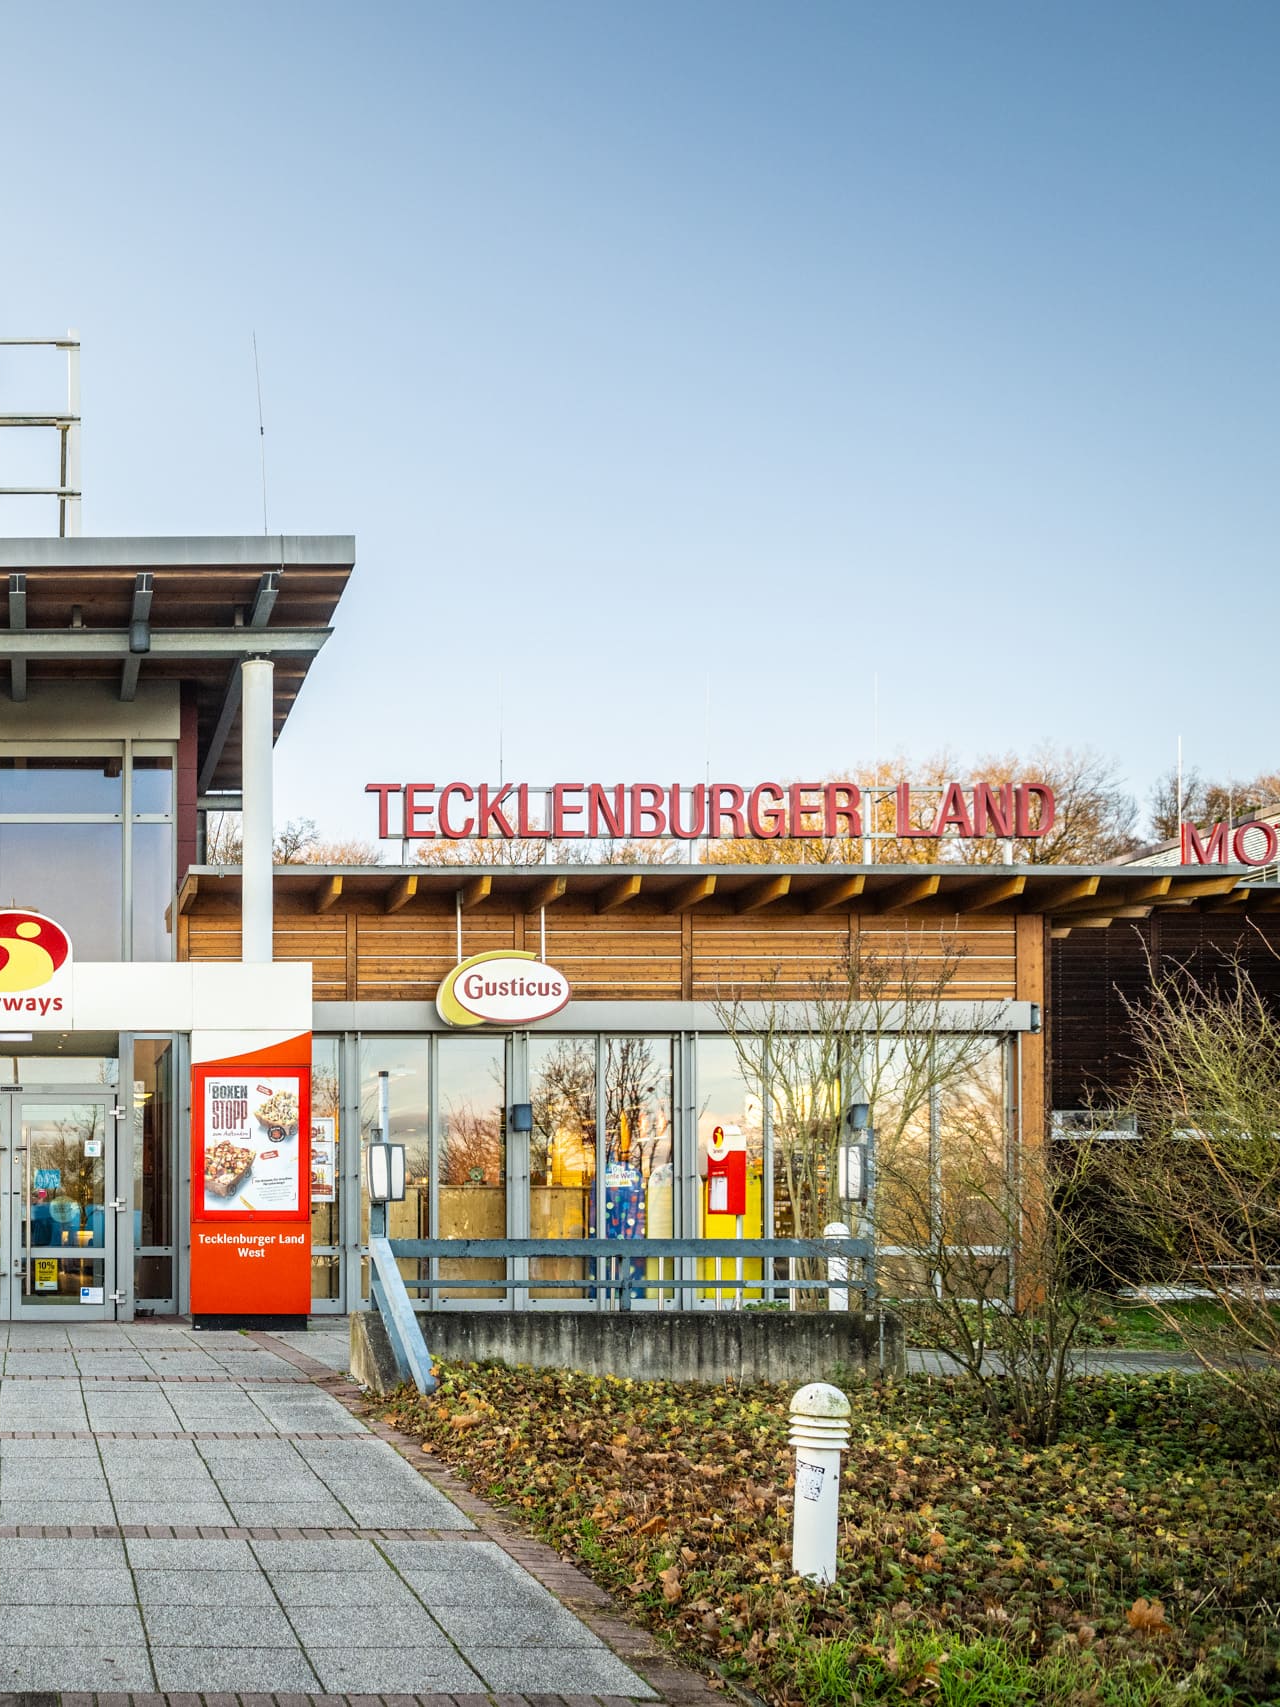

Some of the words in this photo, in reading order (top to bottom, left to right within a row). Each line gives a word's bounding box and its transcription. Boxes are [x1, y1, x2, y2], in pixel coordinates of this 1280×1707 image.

[364, 782, 862, 839] TECKLENBURGER
[896, 782, 1055, 839] LAND
[1181, 821, 1280, 866] MO
[464, 974, 562, 999] Gusticus
[212, 1085, 248, 1099] BOXEN
[212, 1100, 248, 1130] STOPP
[198, 1233, 276, 1246] Tecklenburger
[279, 1233, 305, 1244] Land
[238, 1247, 265, 1258] West
[38, 1261, 55, 1270] 10%
